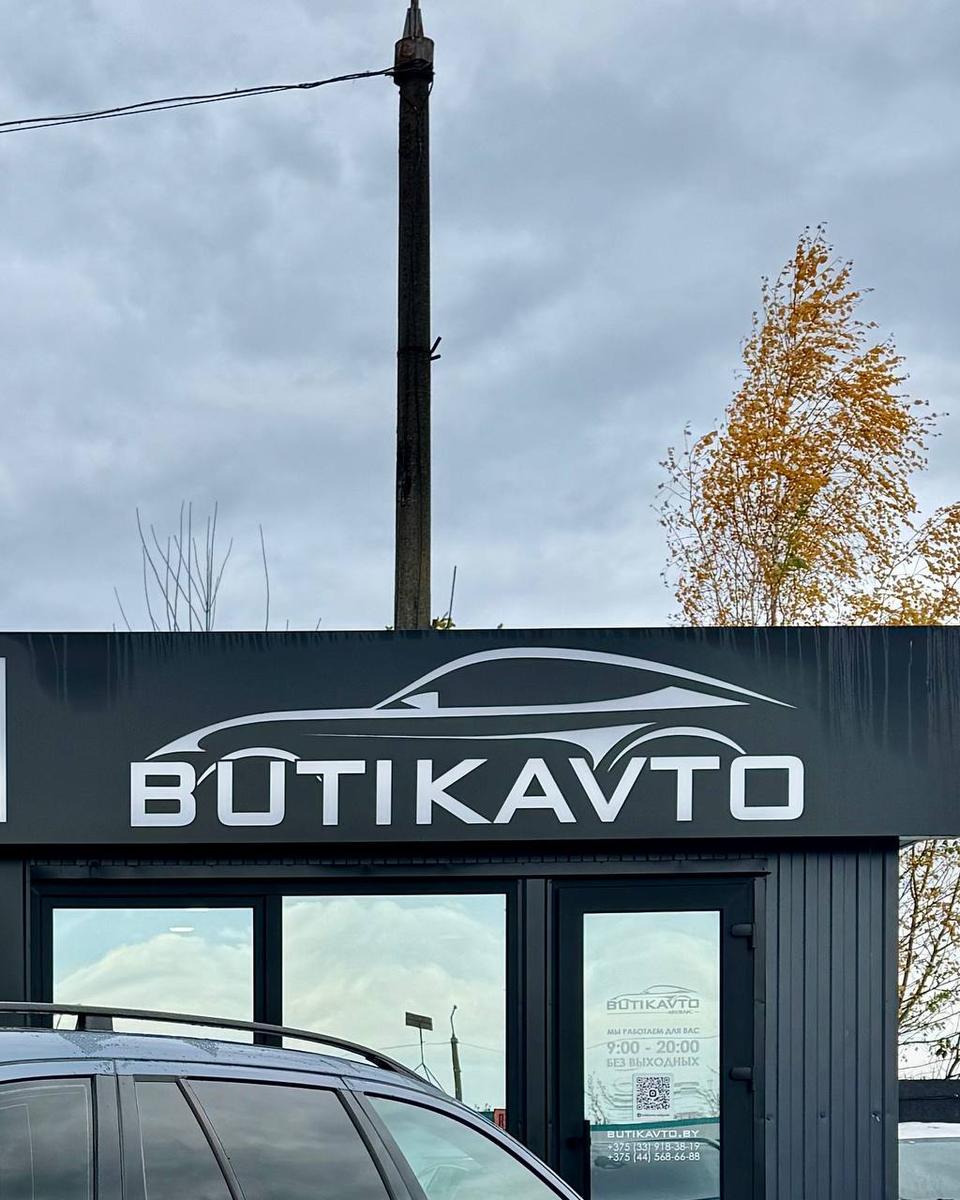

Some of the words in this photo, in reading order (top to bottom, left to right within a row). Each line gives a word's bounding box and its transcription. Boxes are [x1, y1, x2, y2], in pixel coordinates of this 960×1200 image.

[129, 754, 805, 827] BUTIKAVTO
[606, 999, 700, 1010] BUTIKAVTO
[623, 1027, 664, 1035] РАБОТАЕМ
[664, 1027, 681, 1035] ДЛЯ
[607, 1041, 640, 1054] 9:00
[656, 1040, 700, 1054] 20:00
[607, 1057, 626, 1068] БЕЗ
[629, 1056, 700, 1068] ВЫХОДНЫХ
[607, 1130, 700, 1139] BUTIKAVTO.BY
[607, 1143, 630, 1152] +375
[633, 1142, 651, 1153] (33)
[654, 1142, 700, 1151] 918-38-19
[607, 1153, 631, 1161] +375
[633, 1152, 651, 1163] (44)
[654, 1152, 700, 1161] 568-66-88
